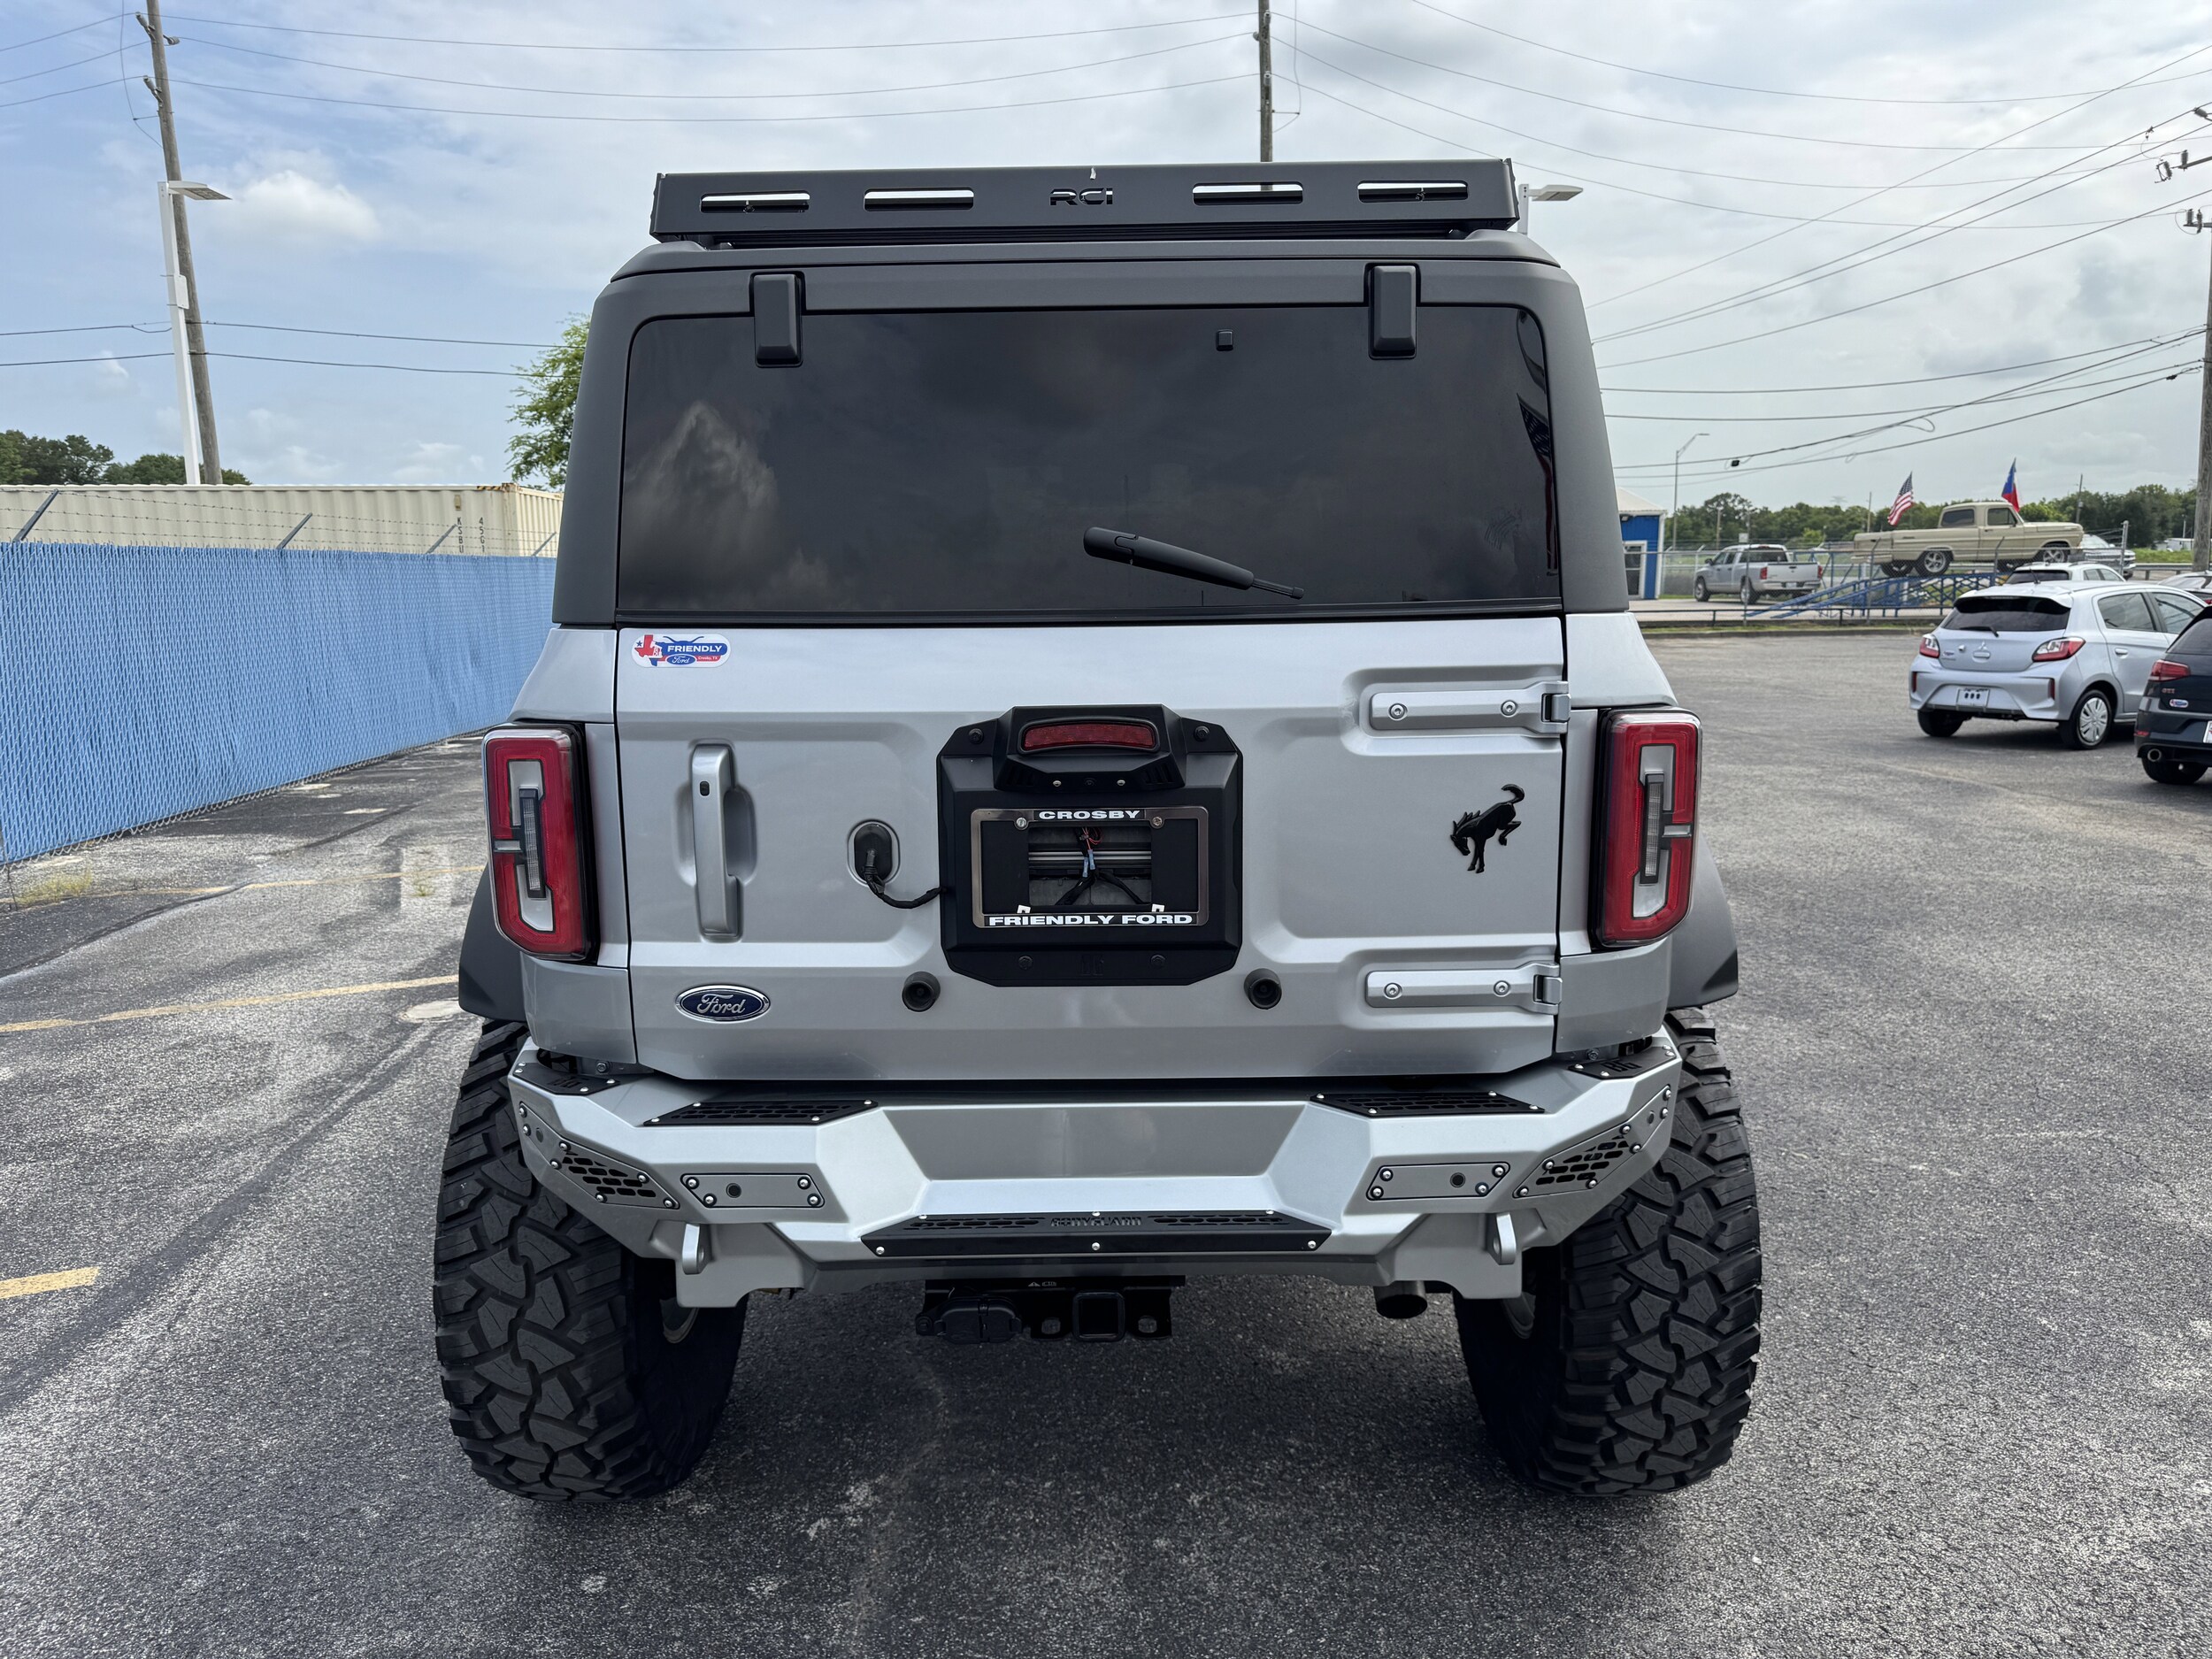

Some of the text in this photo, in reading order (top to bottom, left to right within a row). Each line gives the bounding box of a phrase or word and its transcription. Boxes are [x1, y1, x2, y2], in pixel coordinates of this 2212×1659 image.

[1049, 188, 1113, 205] RCI
[1039, 810, 1140, 820] CROSBY
[988, 914, 1192, 926] FRIENDLY FORD
[696, 993, 747, 1014] Ford
